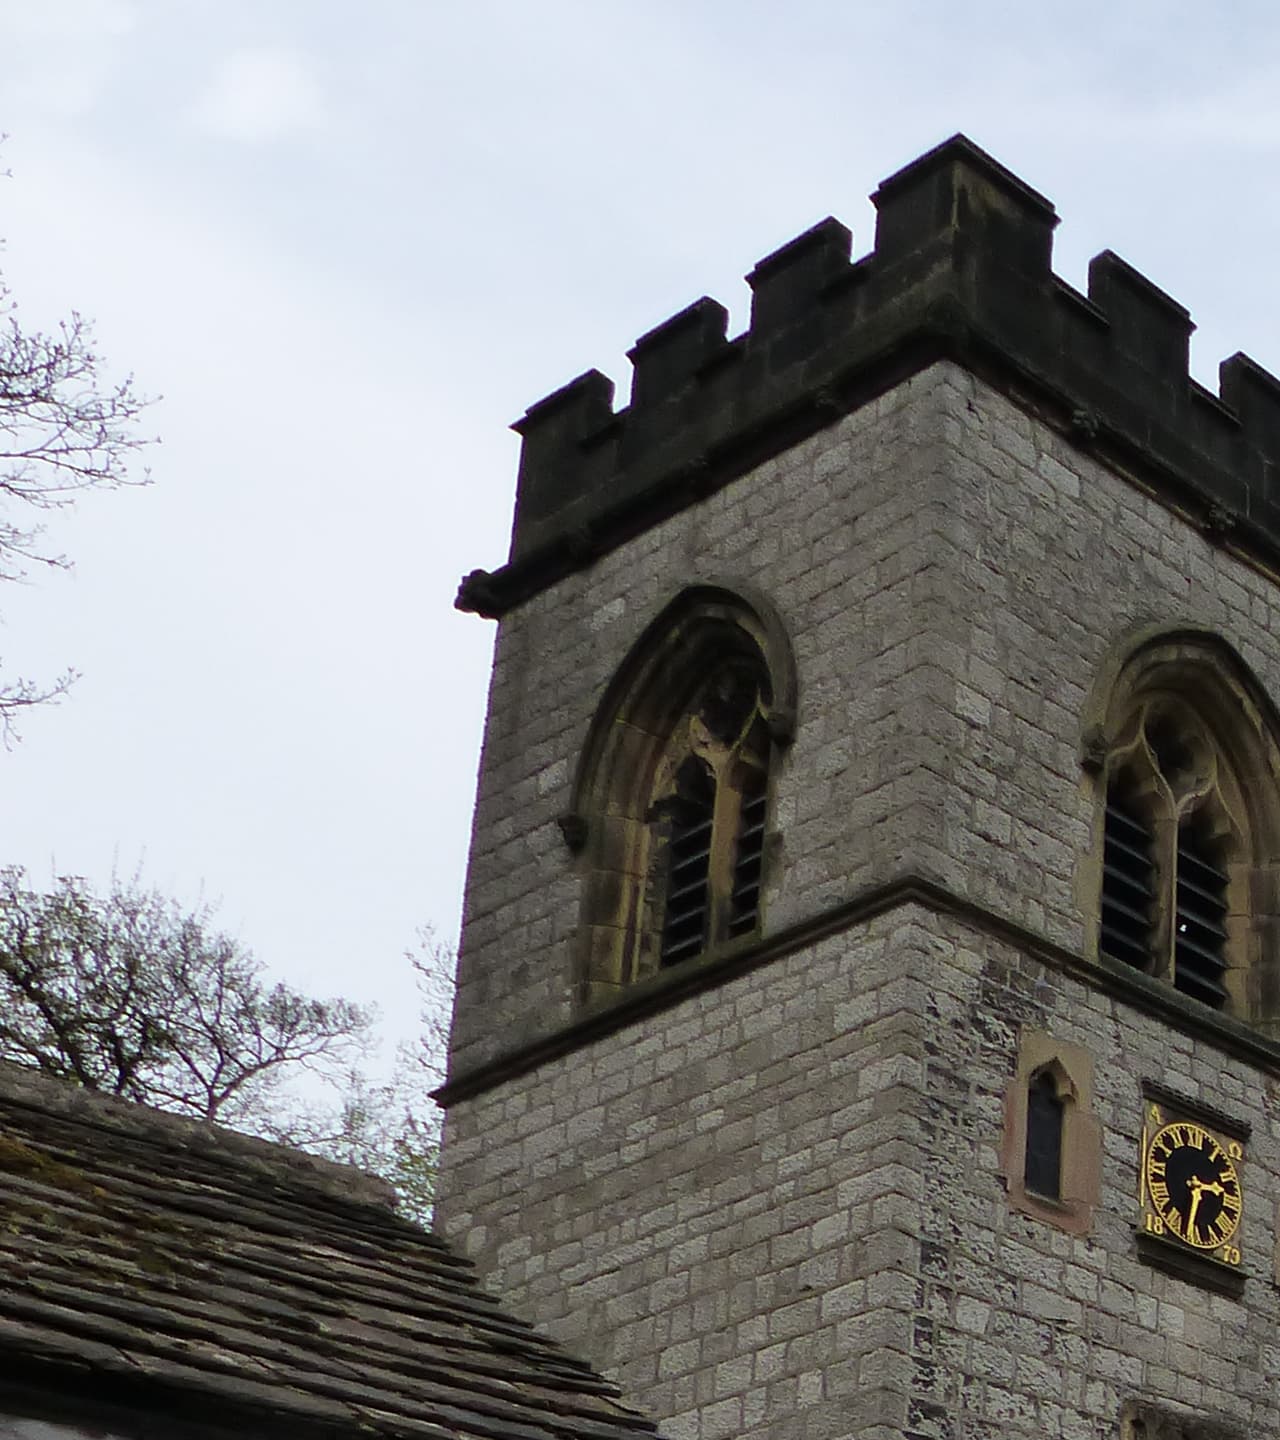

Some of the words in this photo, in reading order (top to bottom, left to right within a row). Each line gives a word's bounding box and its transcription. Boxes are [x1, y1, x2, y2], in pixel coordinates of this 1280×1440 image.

[1187, 1129, 1203, 1150] XII
[1219, 1169, 1234, 1183] II
[1223, 1192, 1239, 1211] III
[1145, 1214, 1163, 1235] 18
[1223, 1246, 1241, 1265] 73
